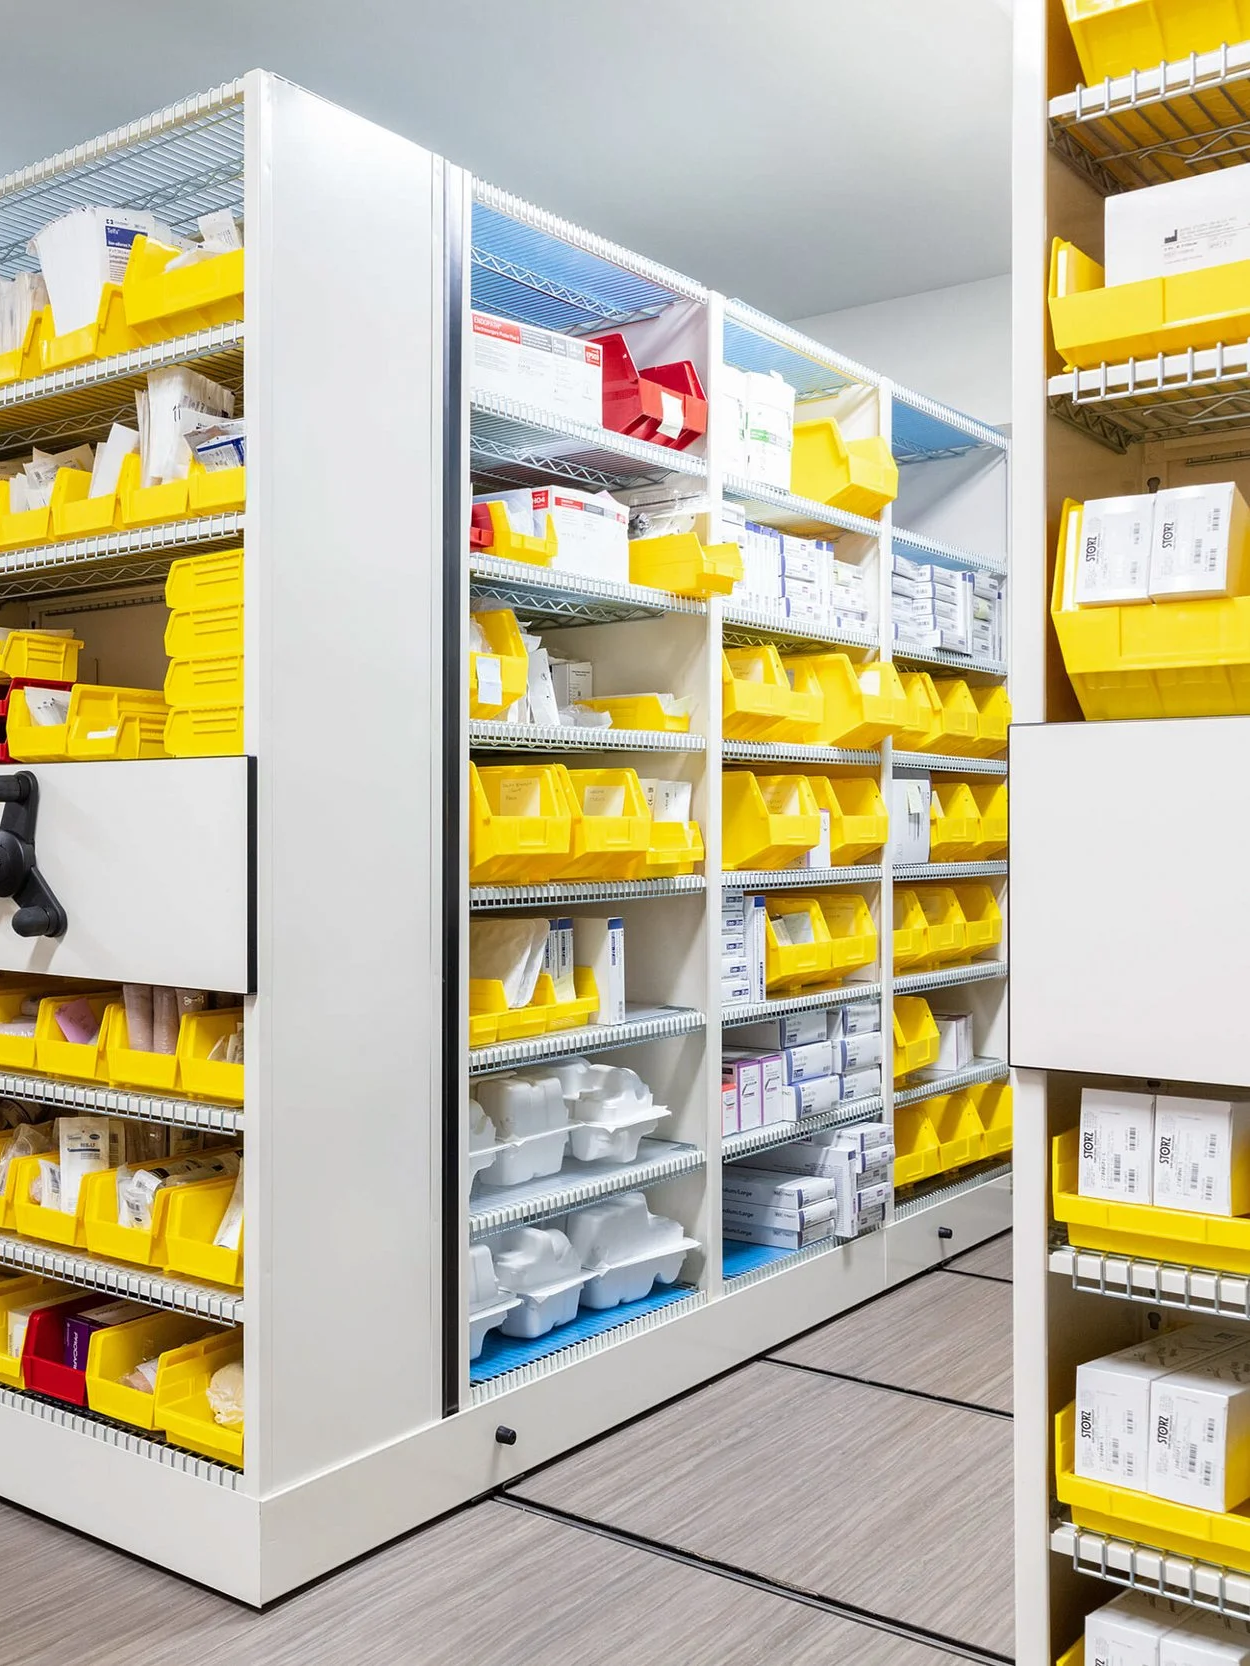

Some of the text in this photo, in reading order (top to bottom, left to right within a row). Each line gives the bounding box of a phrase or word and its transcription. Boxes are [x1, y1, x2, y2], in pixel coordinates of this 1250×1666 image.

[1085, 536, 1097, 562] STORZ
[1162, 521, 1174, 549] STORZ
[1083, 1131, 1094, 1159] STORZ
[1159, 1136, 1171, 1164] STORZ
[1081, 1410, 1092, 1439] STORZ
[1157, 1415, 1169, 1445] STORZ
